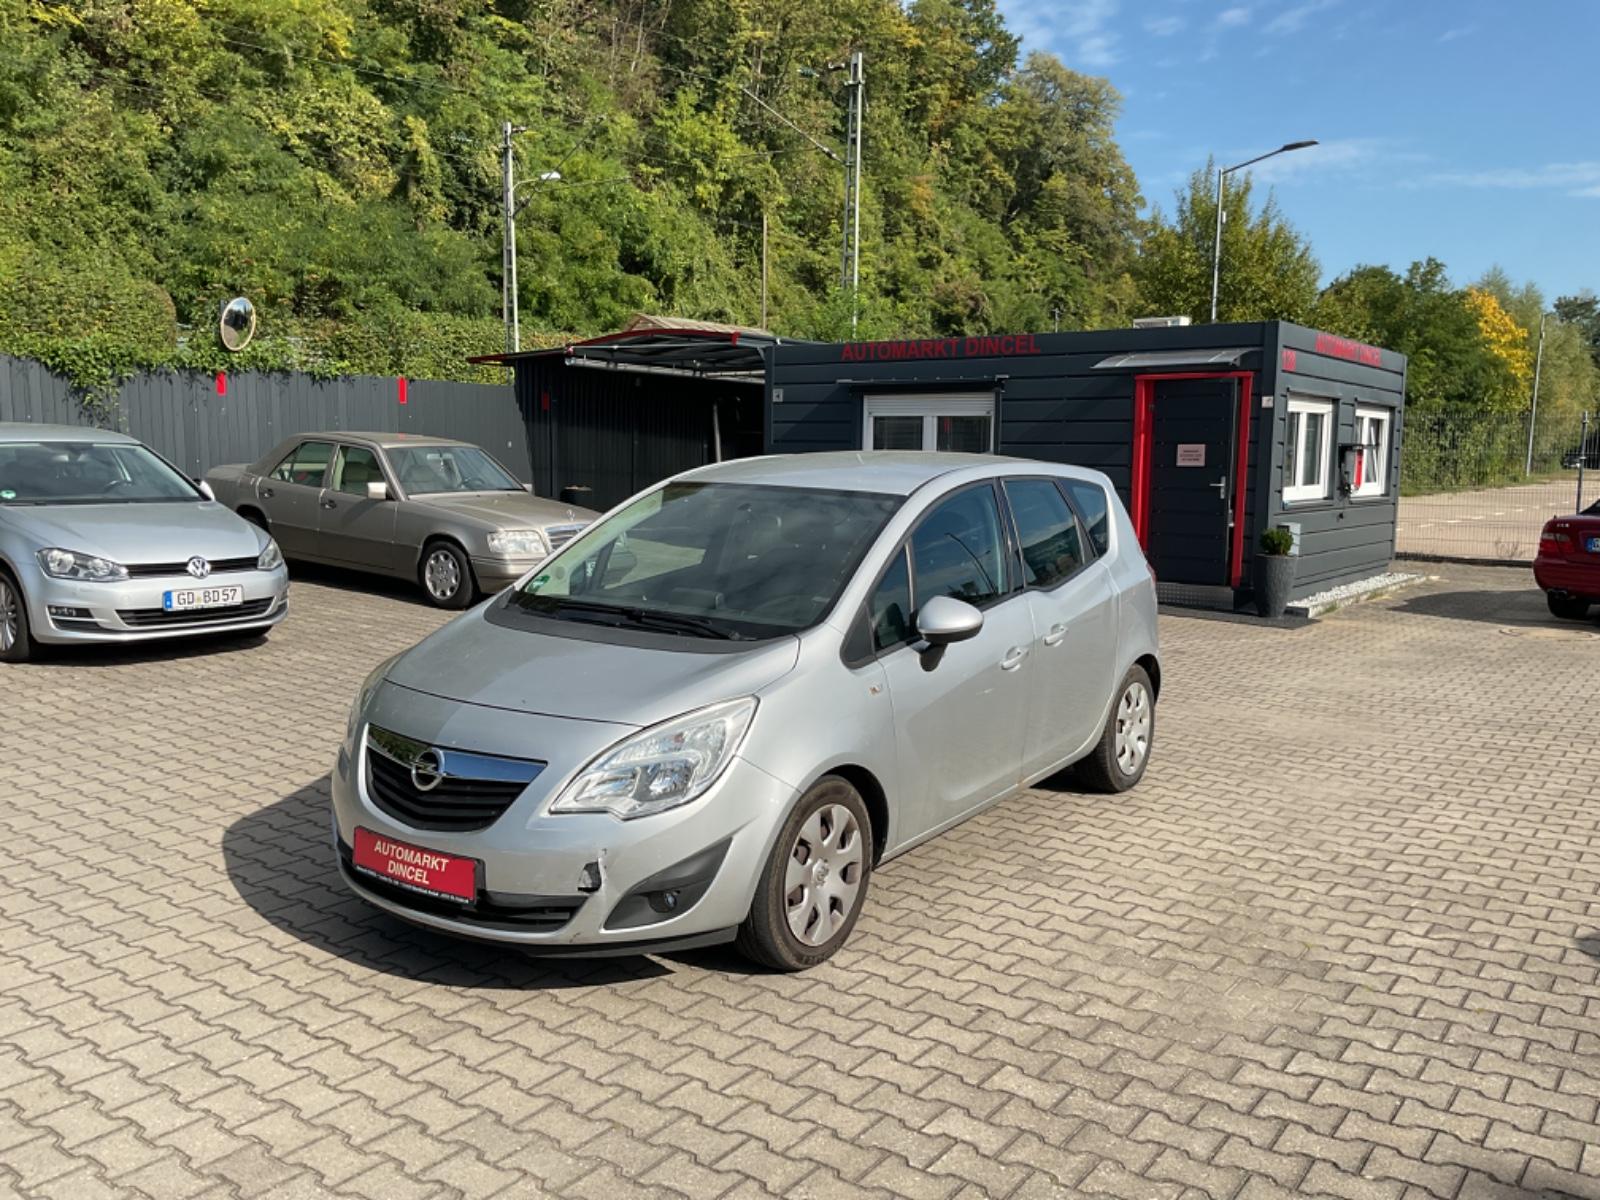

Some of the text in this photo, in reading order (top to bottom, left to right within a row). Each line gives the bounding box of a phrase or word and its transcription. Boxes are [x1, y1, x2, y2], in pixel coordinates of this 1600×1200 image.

[841, 335, 1041, 362] AUTOMARKT DINCEL
[177, 592, 195, 606] GD
[222, 588, 237, 602] 57
[374, 840, 450, 872] AUTOMARKT
[387, 860, 430, 885] DINCEL
